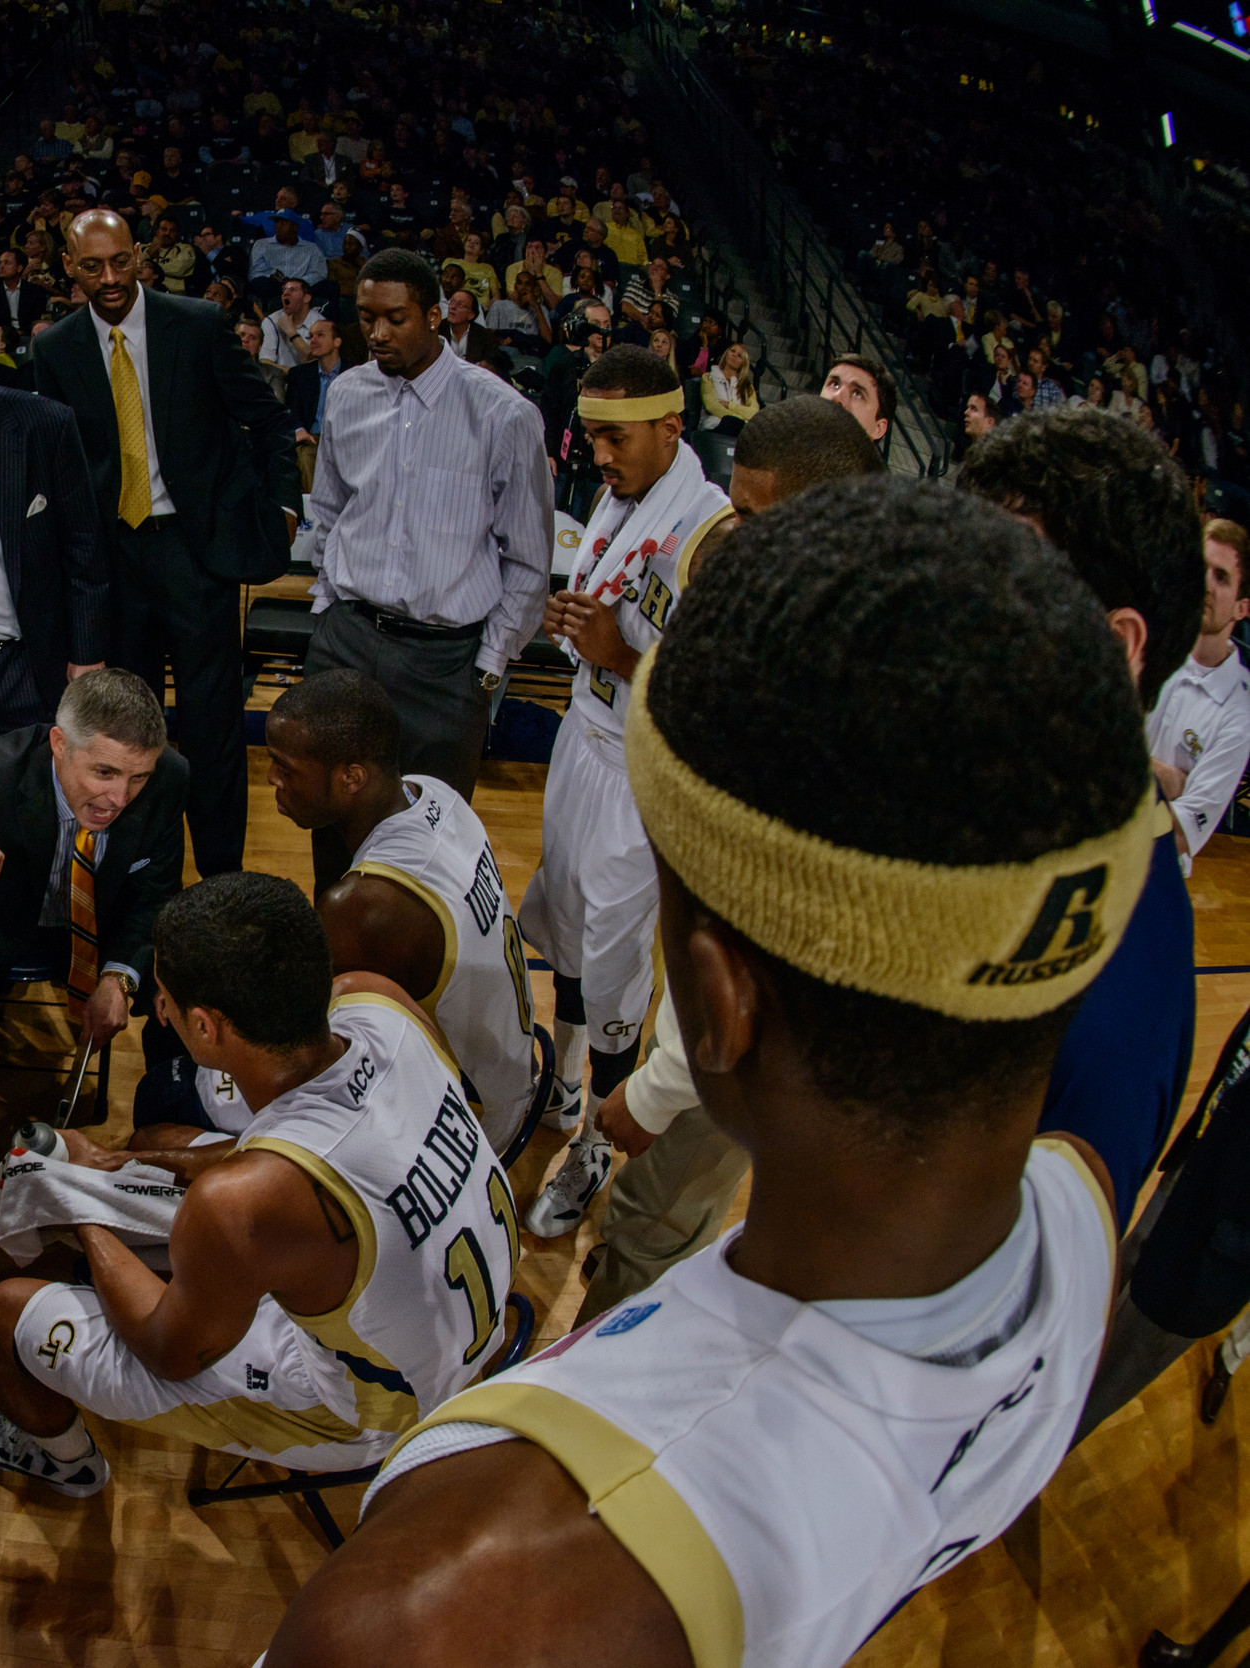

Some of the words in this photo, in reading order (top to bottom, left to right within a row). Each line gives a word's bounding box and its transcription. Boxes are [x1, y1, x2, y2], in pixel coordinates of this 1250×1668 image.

[347, 1056, 375, 1105] ACC
[385, 1080, 480, 1250] BOLDEN
[114, 1183, 187, 1198] POWERA
